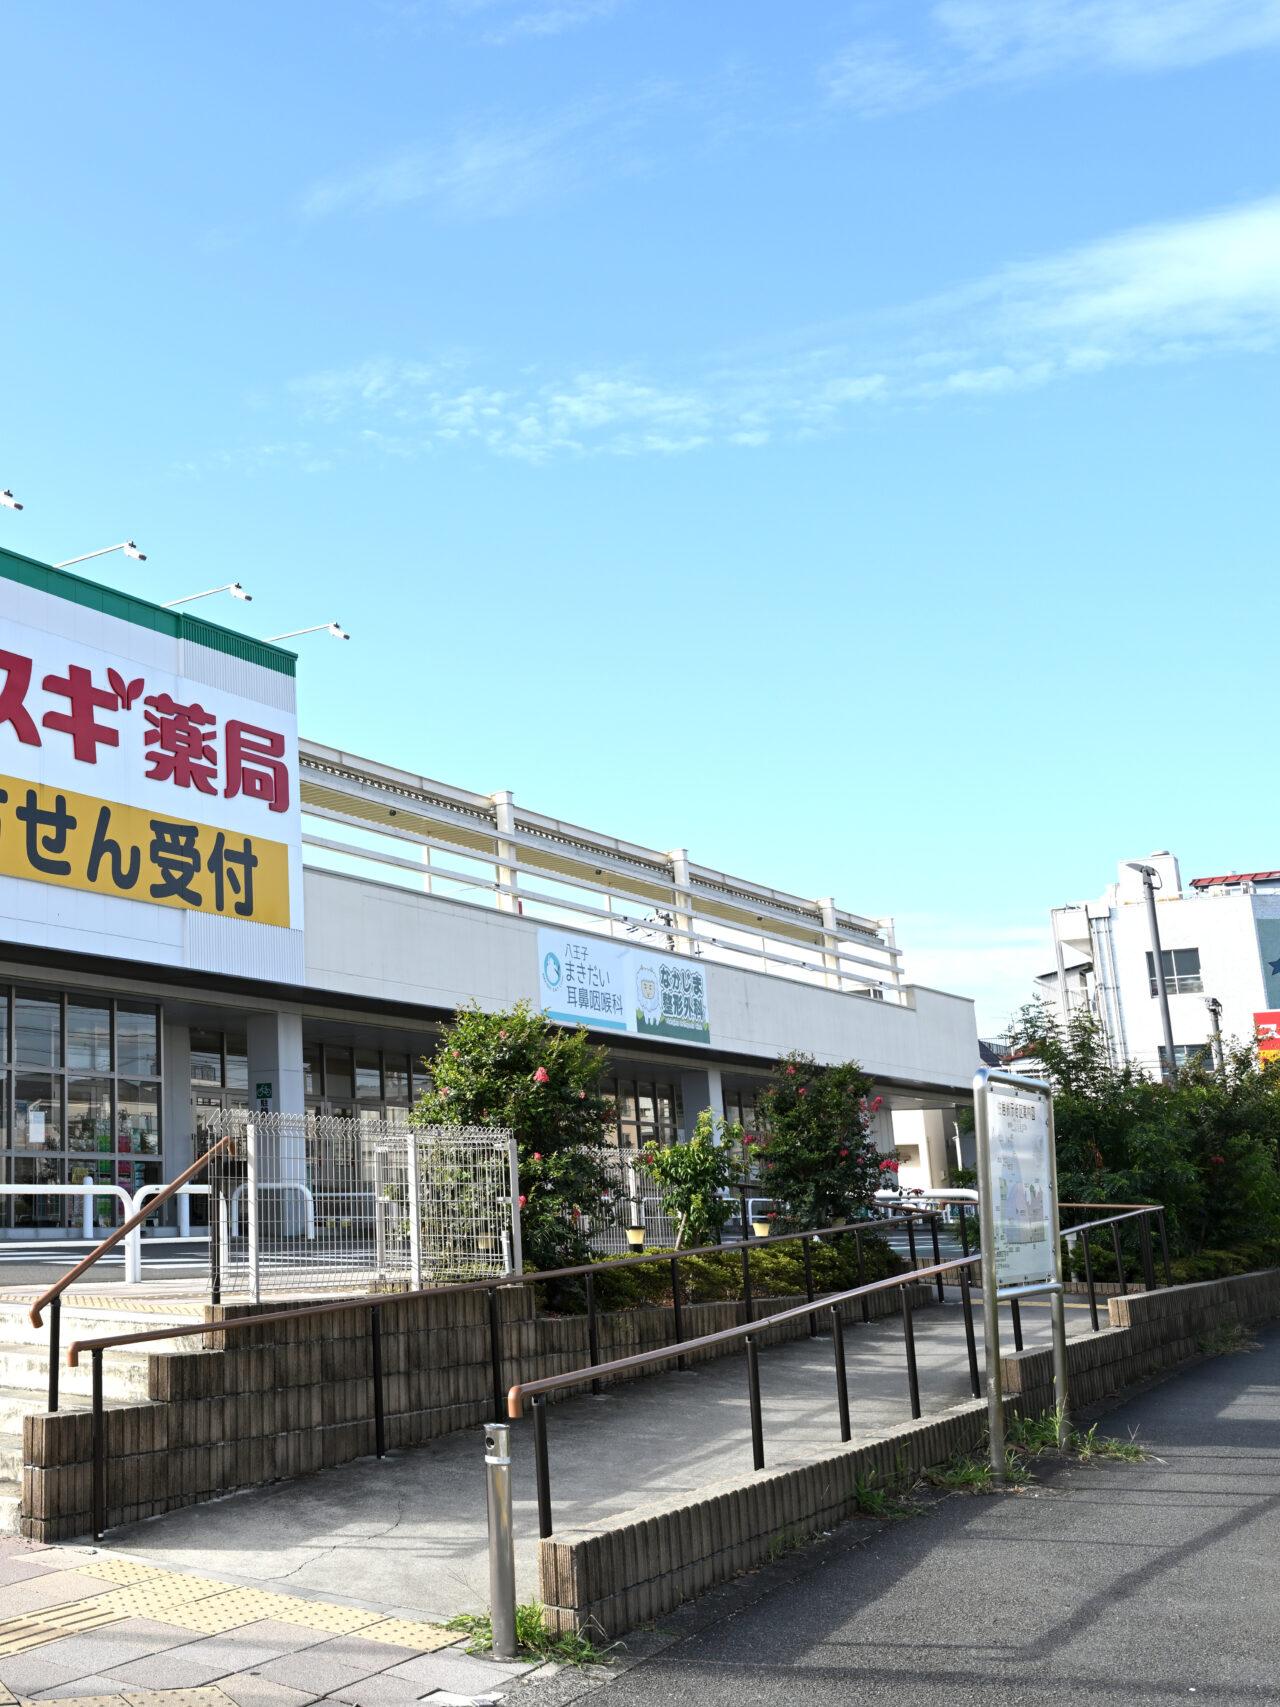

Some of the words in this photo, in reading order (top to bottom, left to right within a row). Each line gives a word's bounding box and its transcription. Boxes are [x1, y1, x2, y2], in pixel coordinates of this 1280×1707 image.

[564, 943, 588, 961] 八王子
[564, 961, 611, 988] まきだい
[660, 965, 703, 996] なかじま
[566, 985, 623, 1016] 耳鼻咽喉科
[662, 991, 704, 1021] 整形外科
